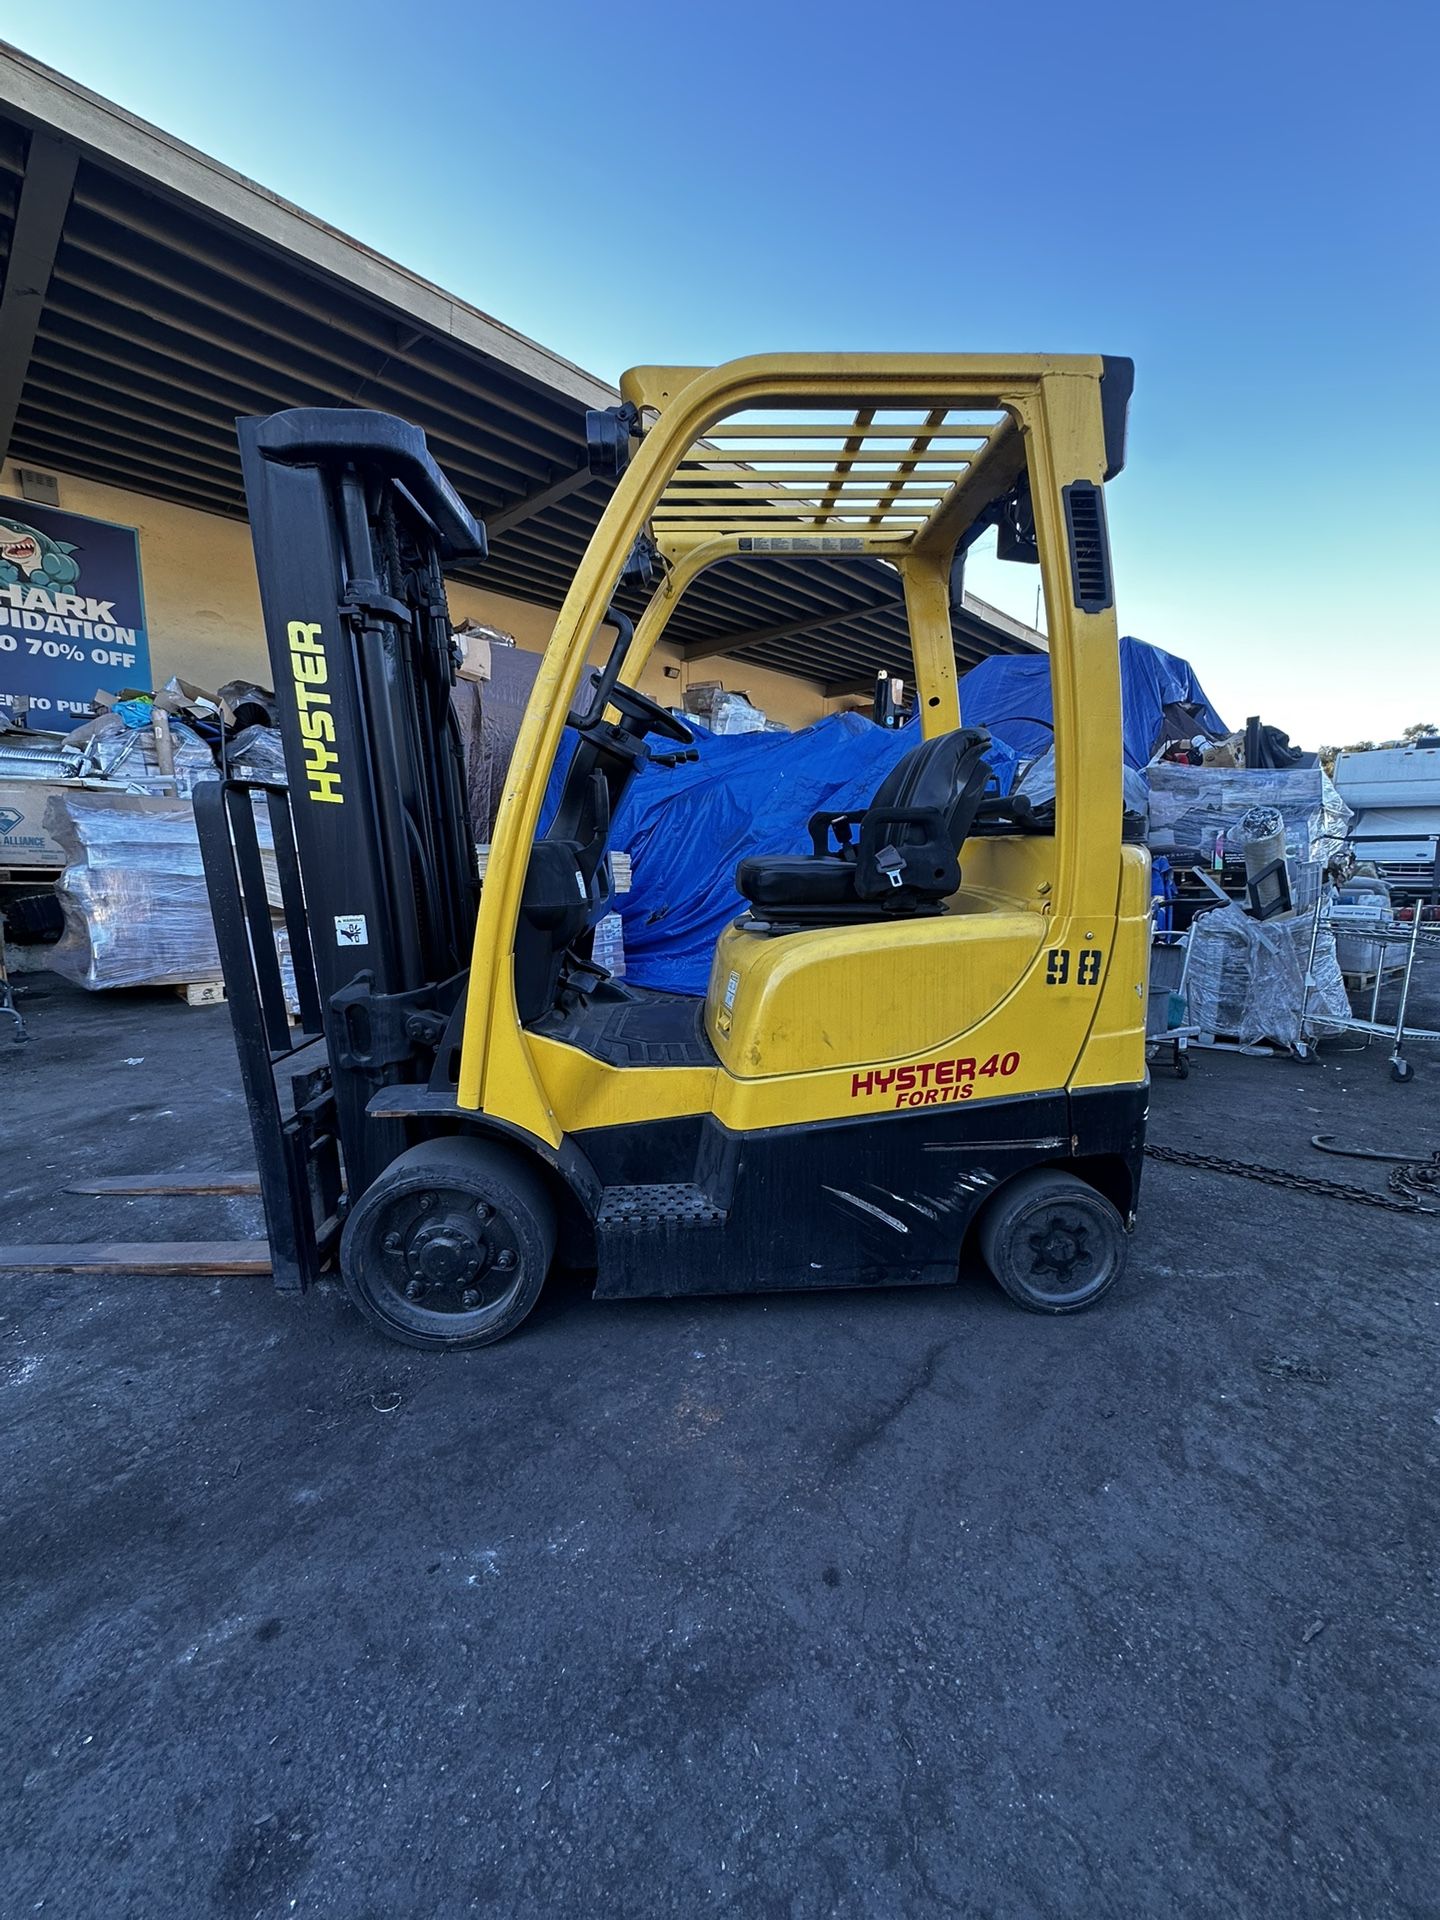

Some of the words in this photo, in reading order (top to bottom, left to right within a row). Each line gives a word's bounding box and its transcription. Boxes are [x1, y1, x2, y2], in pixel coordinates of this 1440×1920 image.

[26, 638, 84, 661] 70%
[91, 648, 136, 668] OFF
[287, 621, 344, 803] HYSTER
[4, 836, 45, 846] ALLIANCE
[1046, 950, 1102, 985] 98
[851, 1057, 976, 1097] HYSTER
[978, 1051, 1020, 1078] 40
[895, 1083, 973, 1108] FORTIS
